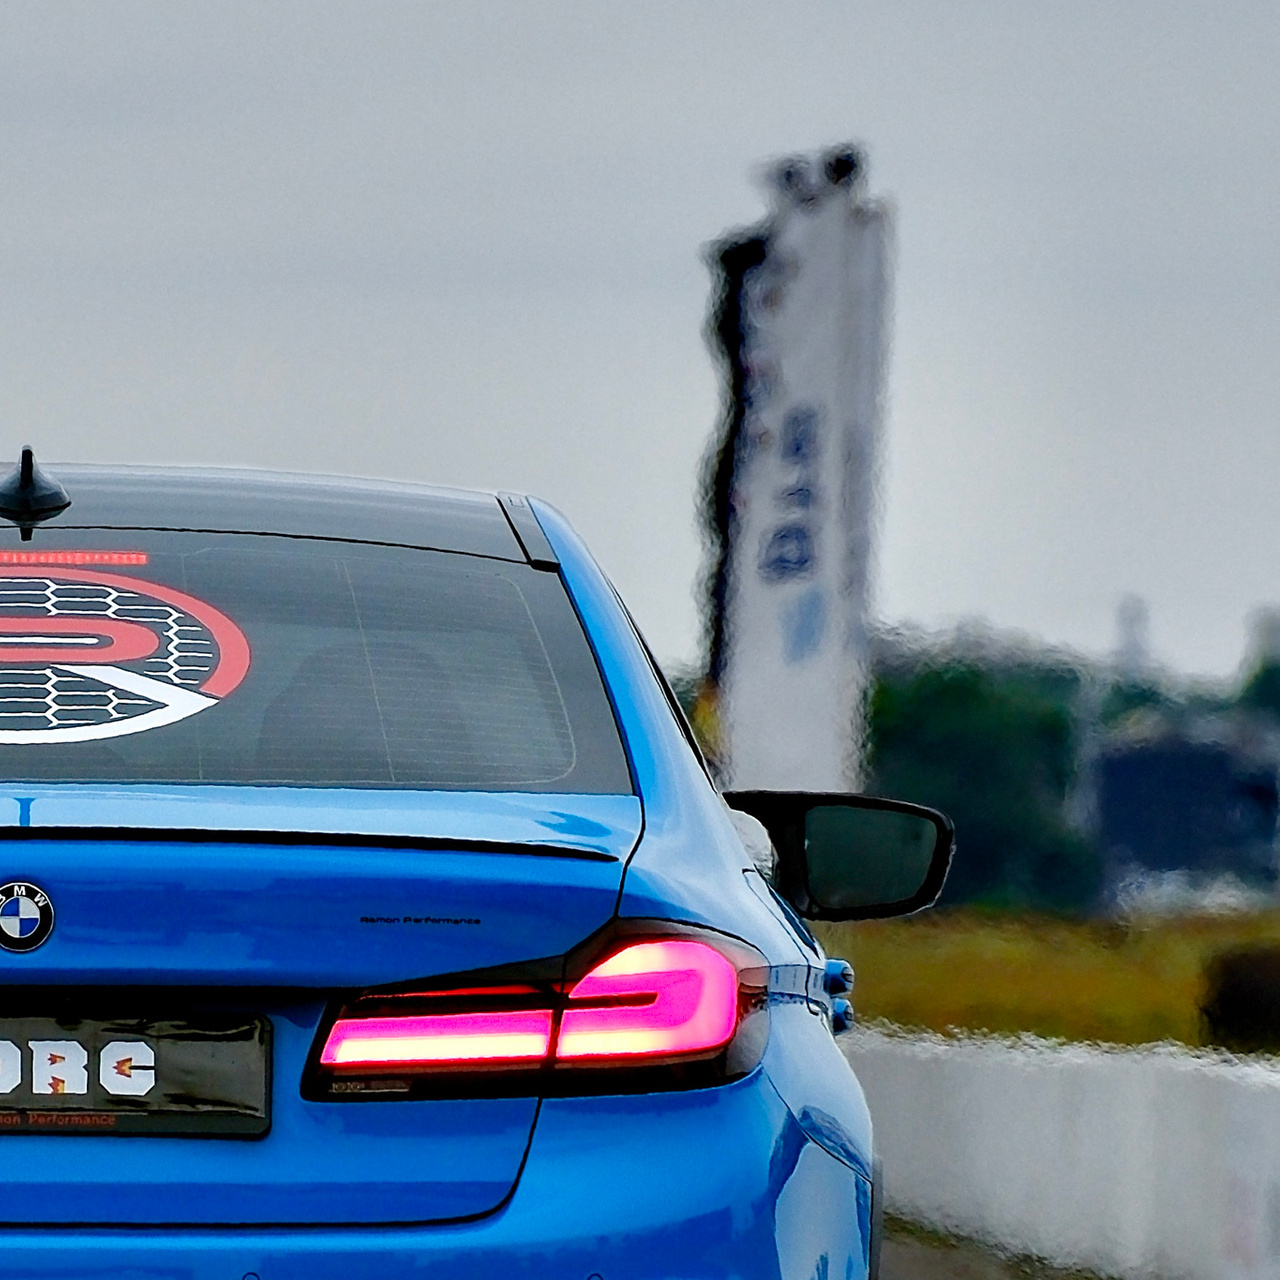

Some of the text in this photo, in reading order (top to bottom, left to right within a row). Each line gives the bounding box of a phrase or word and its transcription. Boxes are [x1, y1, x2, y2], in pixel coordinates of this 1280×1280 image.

[360, 916, 481, 925] Ramon Performance
[28, 1114, 116, 1125] Performance
